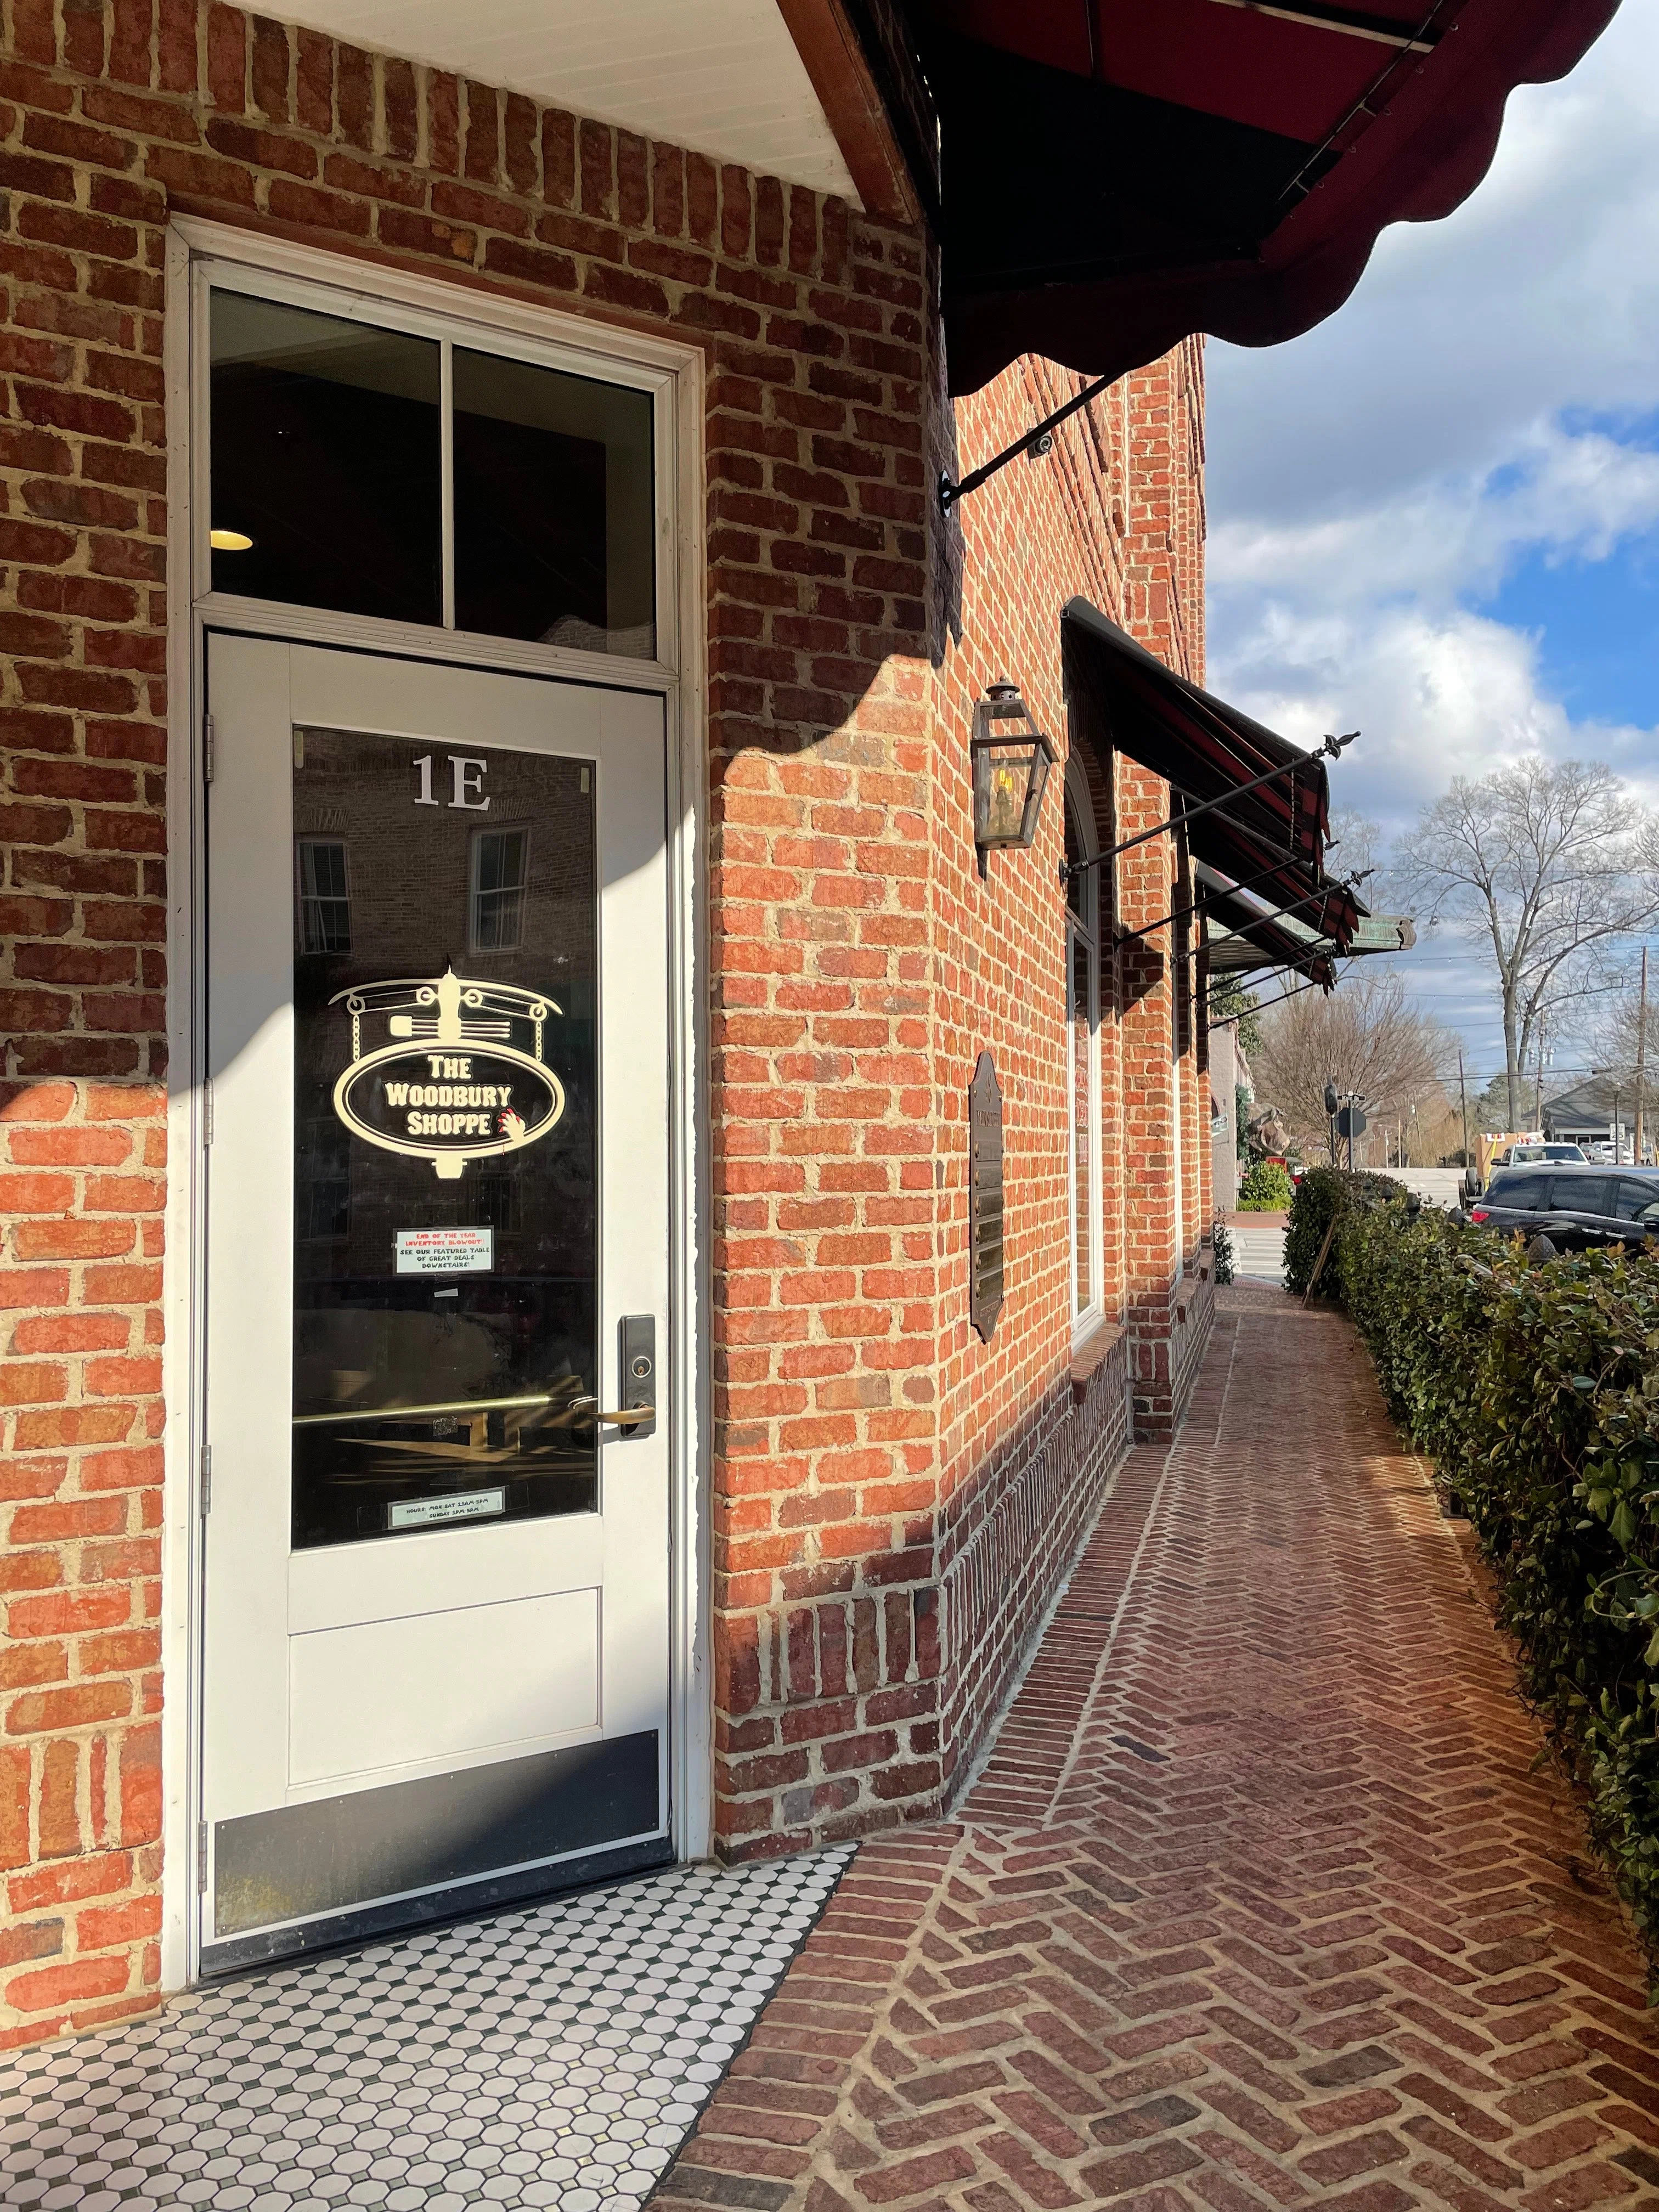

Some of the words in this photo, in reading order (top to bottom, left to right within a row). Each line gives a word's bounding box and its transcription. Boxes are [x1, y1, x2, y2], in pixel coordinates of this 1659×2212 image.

[413, 755, 491, 811] 1E
[427, 1054, 472, 1079] THE
[385, 1082, 512, 1107] WOODBURY
[407, 1110, 491, 1135] SHOPPE
